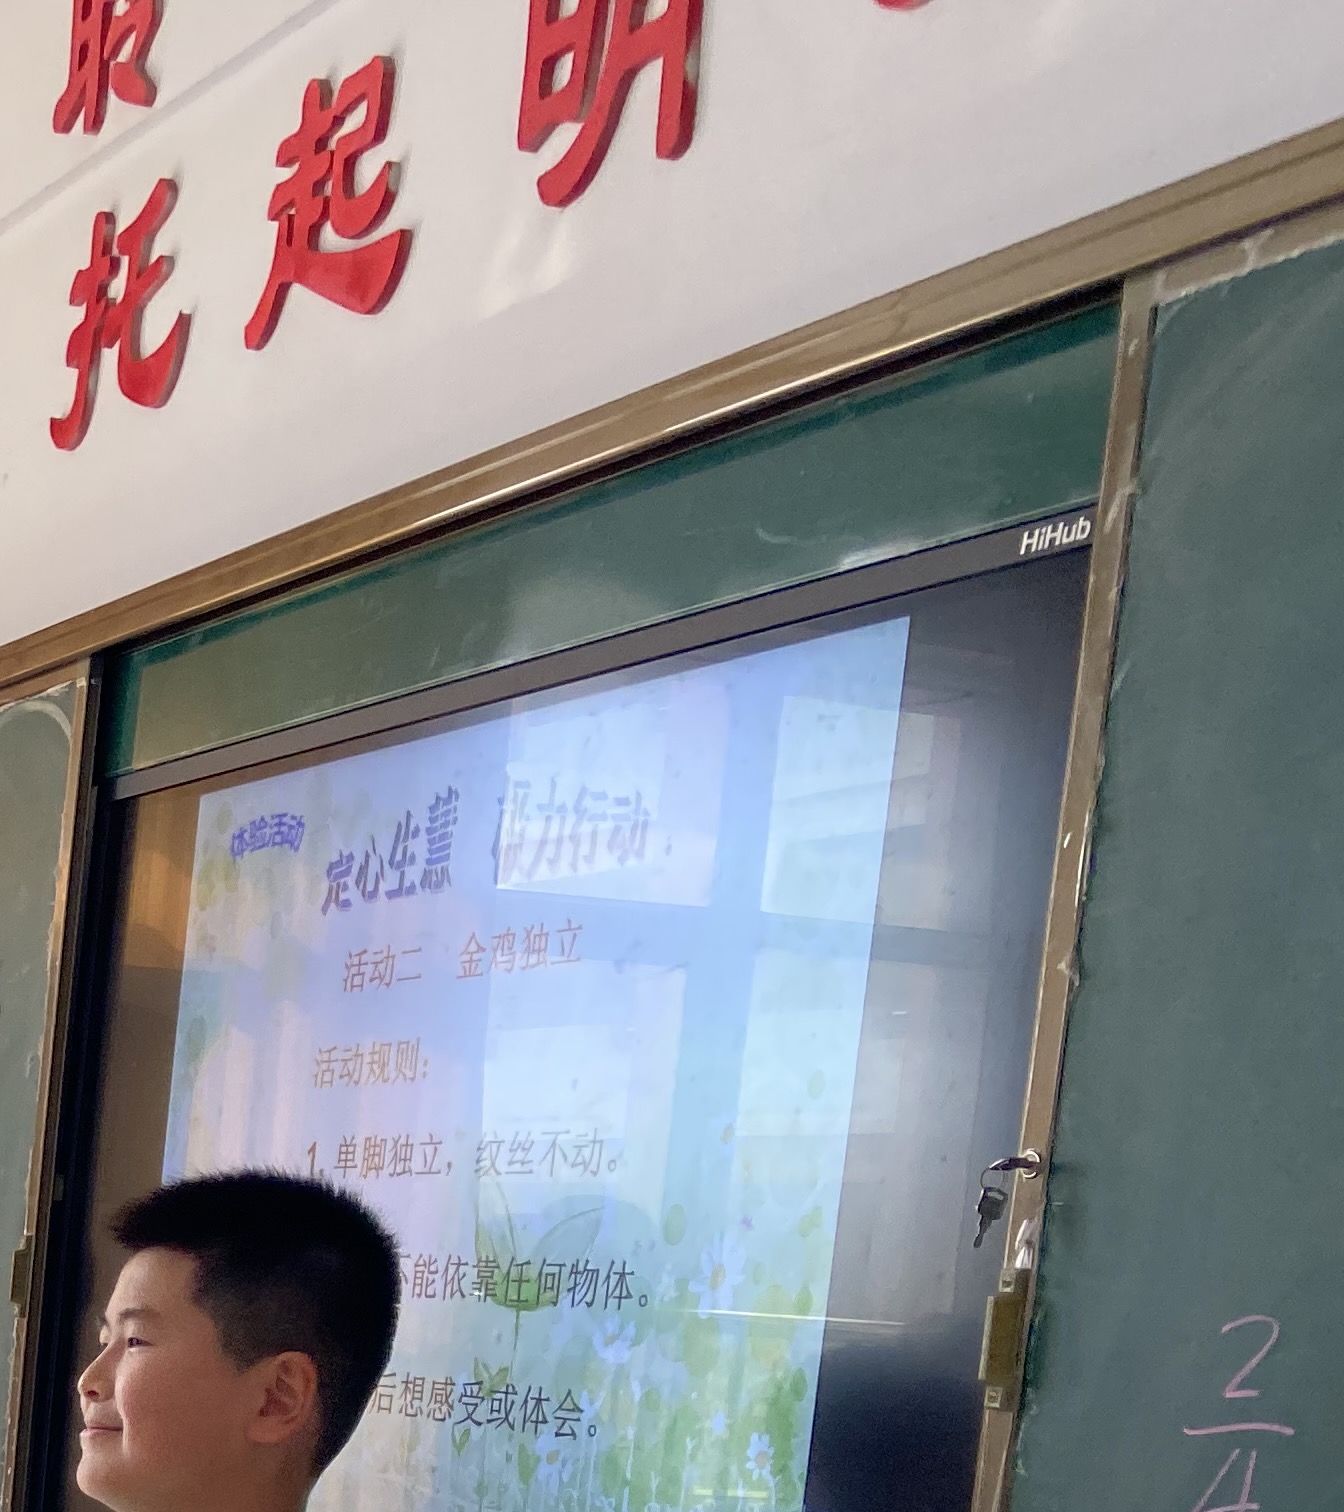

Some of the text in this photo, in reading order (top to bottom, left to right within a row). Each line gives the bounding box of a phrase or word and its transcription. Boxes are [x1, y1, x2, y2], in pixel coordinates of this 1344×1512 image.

[1019, 516, 1092, 556] HiHub
[231, 812, 305, 859] 体验活动
[321, 786, 460, 915] 定心生慧
[342, 917, 583, 993] 活动二 金鸡独立
[1220, 1314, 1281, 1399] 2
